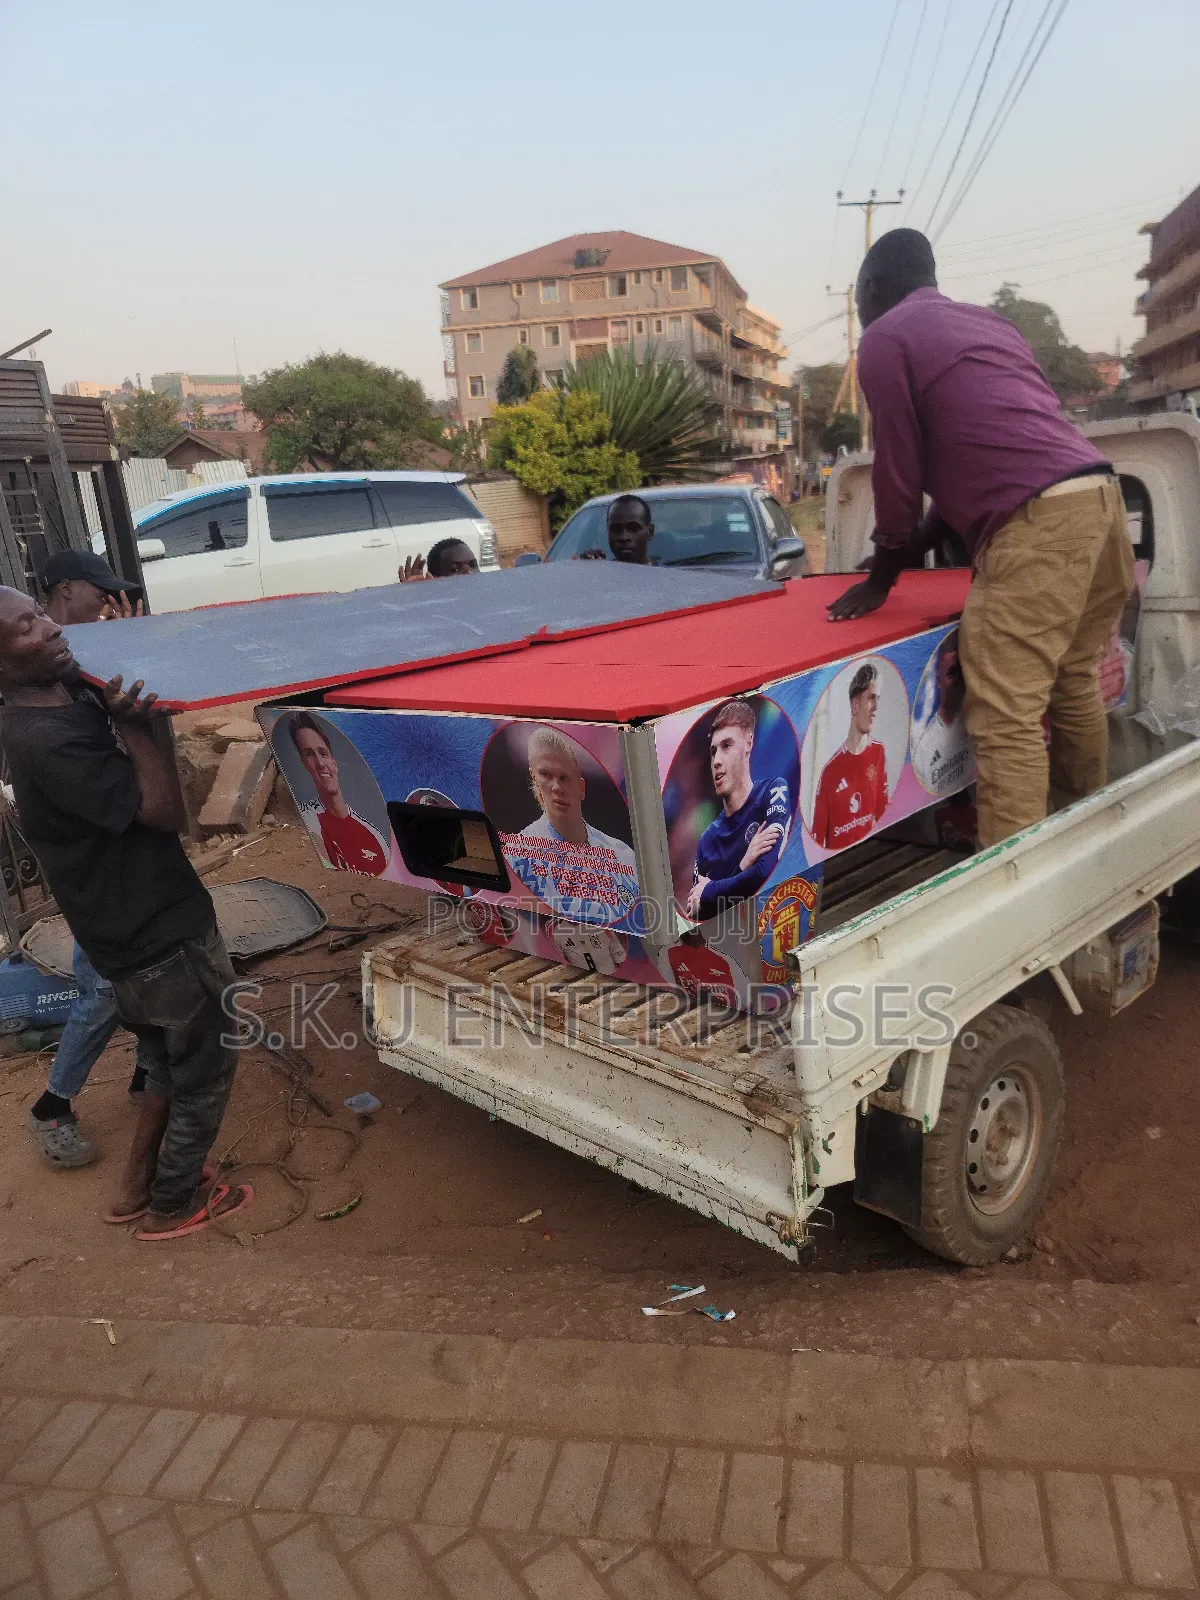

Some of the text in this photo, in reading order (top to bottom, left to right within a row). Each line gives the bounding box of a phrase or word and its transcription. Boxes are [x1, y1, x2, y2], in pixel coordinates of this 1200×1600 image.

[833, 813, 873, 837] Snapdragon
[581, 842, 617, 860] Services
[604, 859, 635, 877] Station
[757, 881, 816, 933] MANCHESTER
